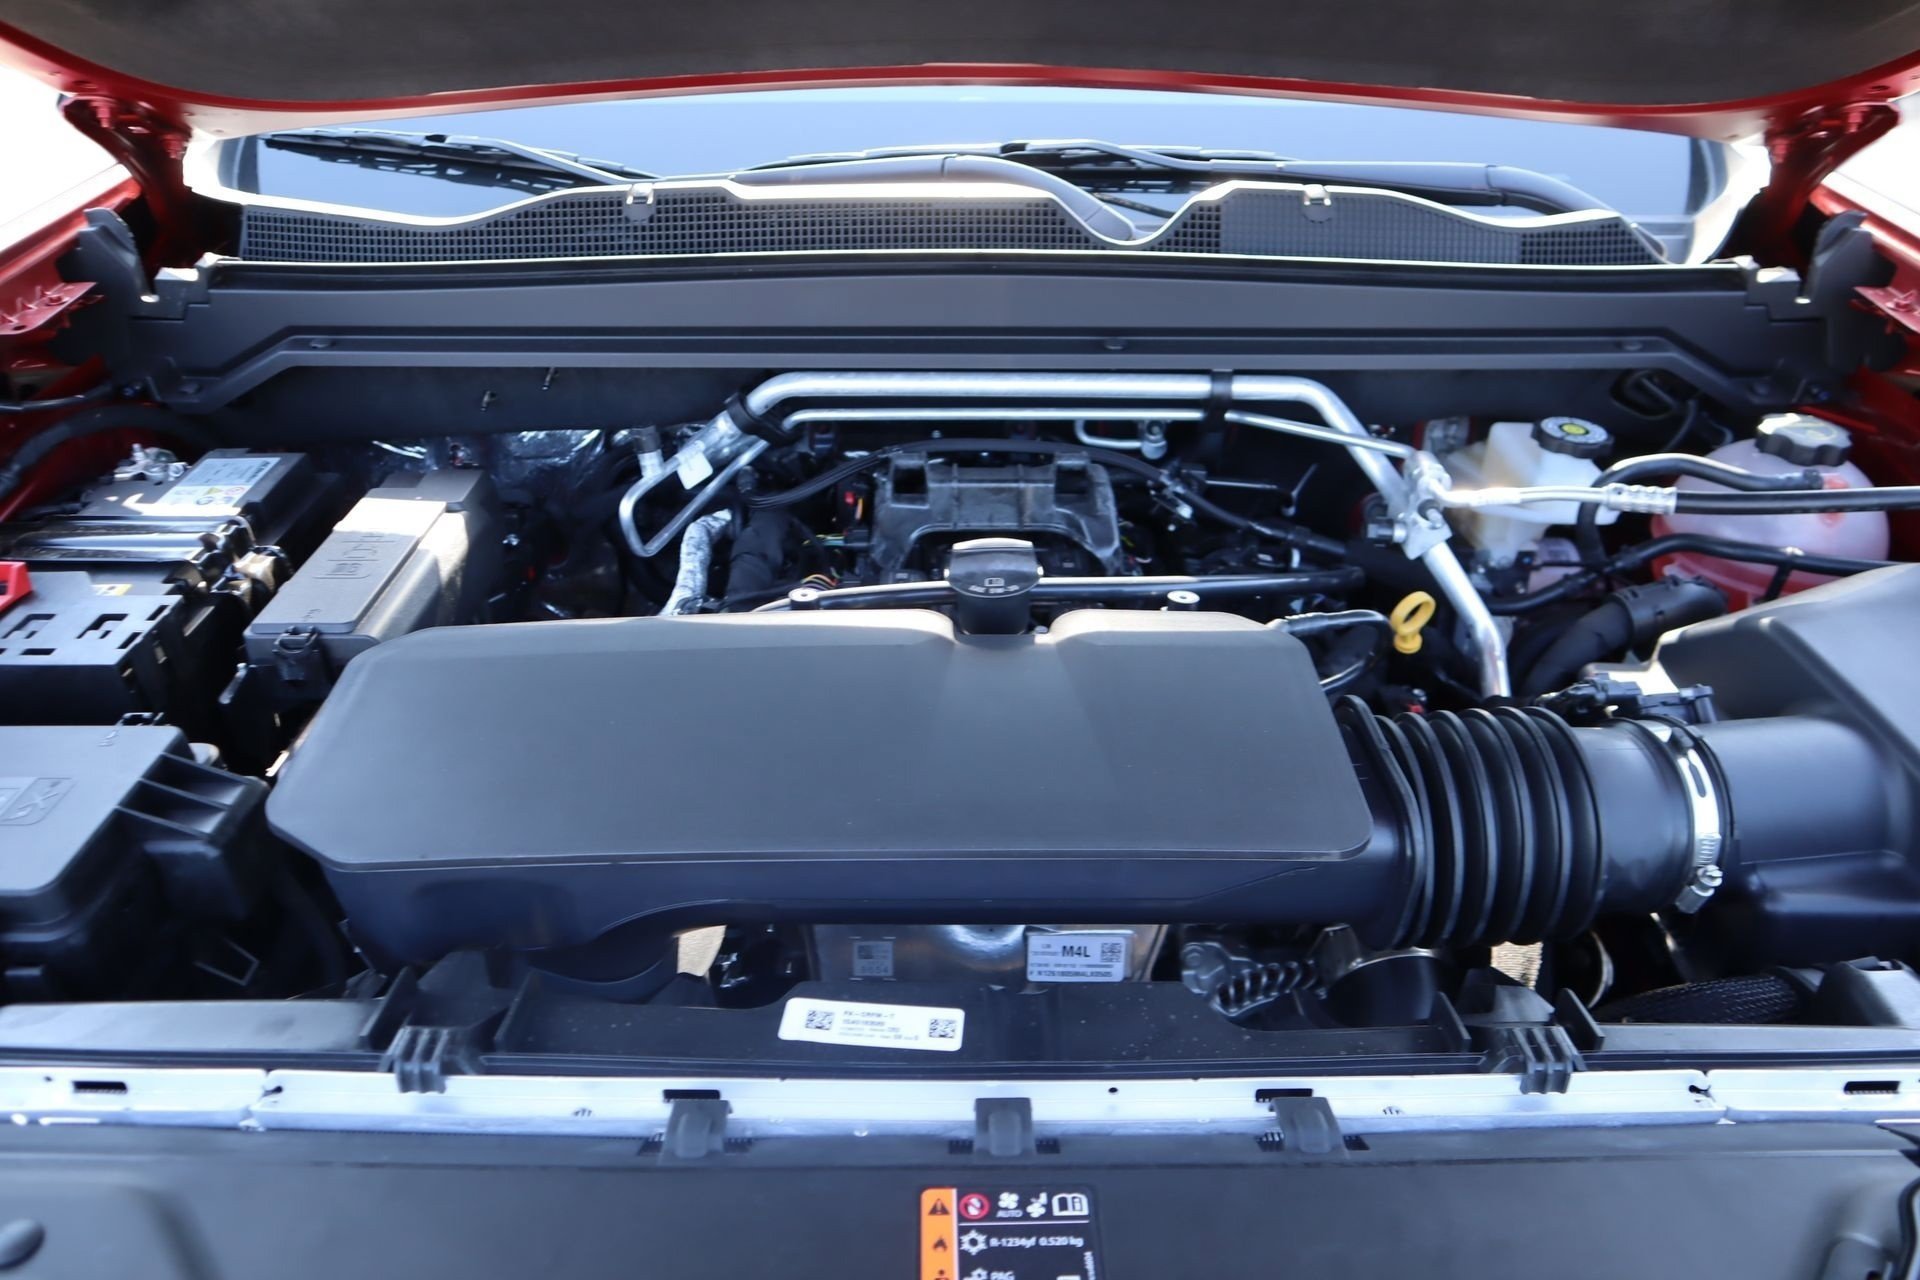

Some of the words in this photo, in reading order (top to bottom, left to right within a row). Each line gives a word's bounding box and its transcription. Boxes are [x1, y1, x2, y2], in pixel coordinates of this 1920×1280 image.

[1061, 945, 1091, 958] M4L
[996, 1209, 1023, 1218] AUTO
[989, 1236, 1037, 1249] R-1234yf
[1069, 1236, 1085, 1248] kg
